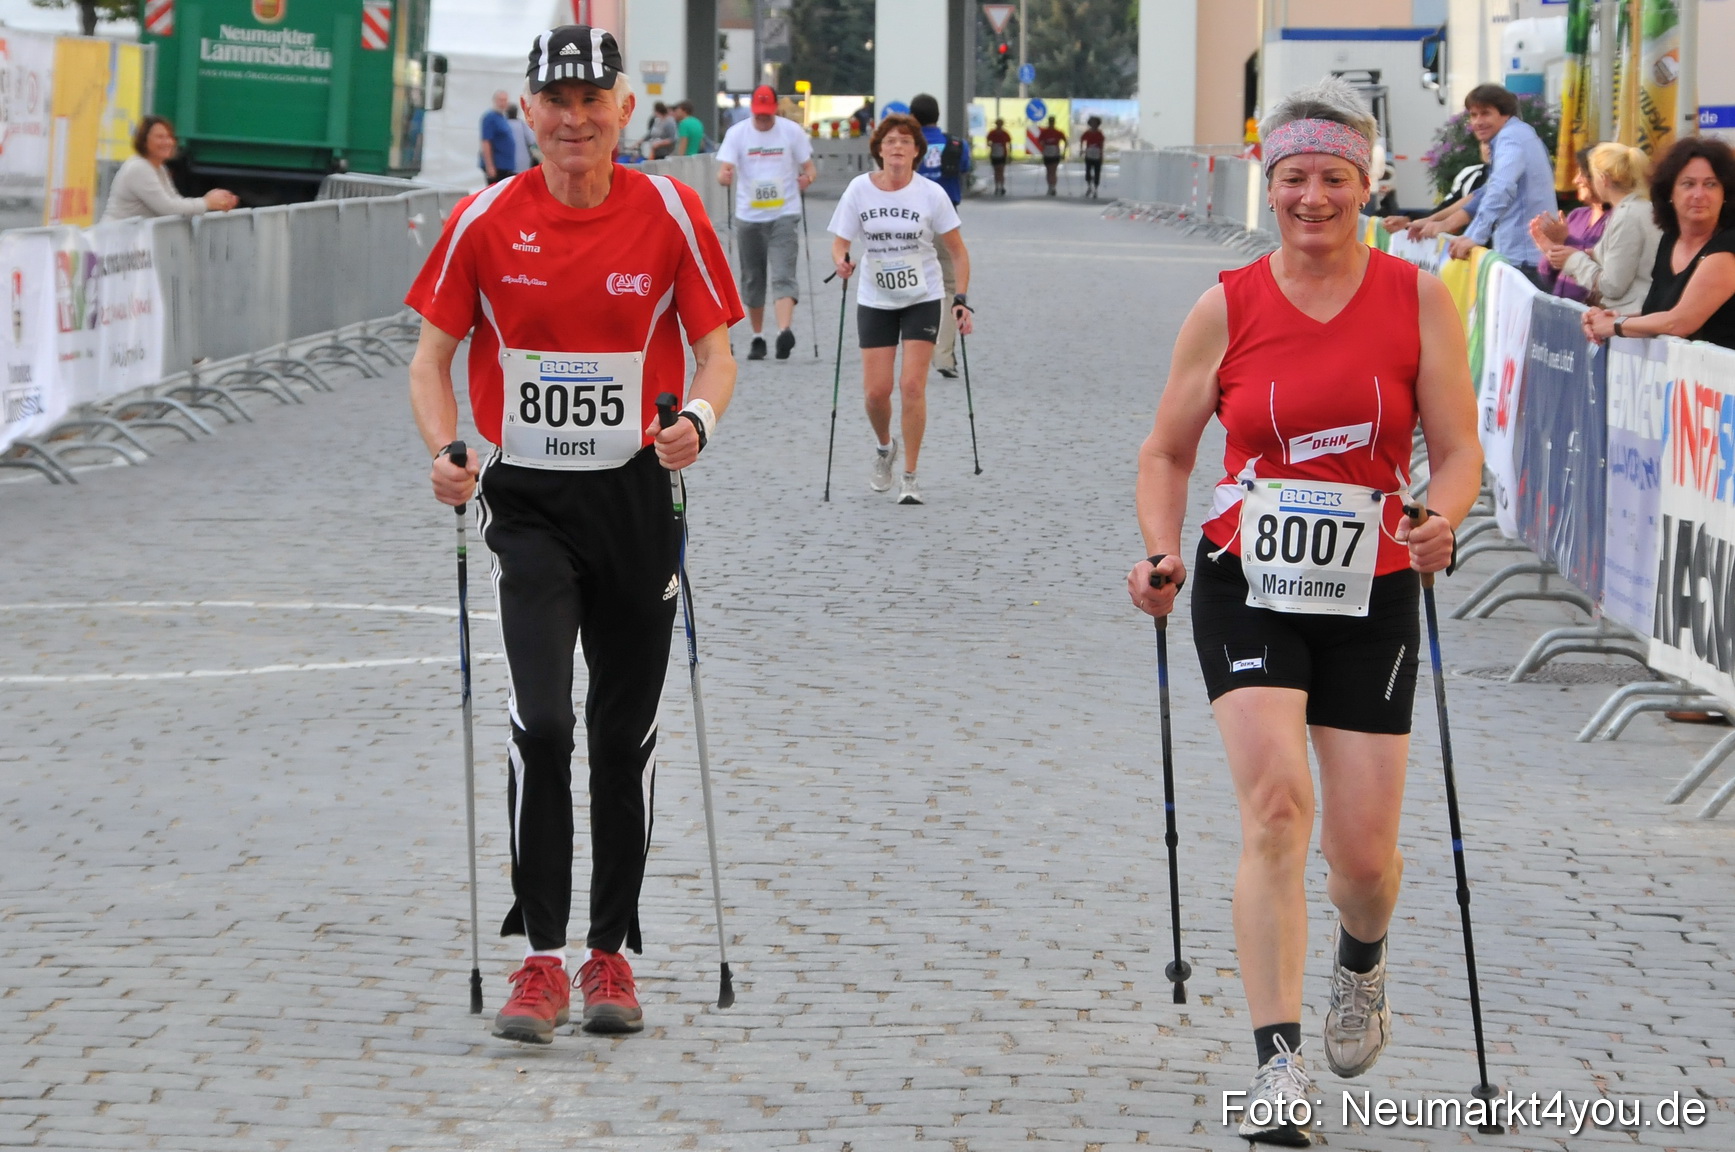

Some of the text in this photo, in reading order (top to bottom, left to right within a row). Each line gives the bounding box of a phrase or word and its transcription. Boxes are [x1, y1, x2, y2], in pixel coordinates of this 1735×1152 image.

[220, 24, 316, 45] Neumarkter
[201, 37, 332, 69] Lammsbräu
[755, 186, 778, 200] 866
[860, 207, 920, 223] BERGER
[512, 242, 541, 253] erima
[876, 268, 918, 290] 8085
[540, 360, 599, 374] BOCK
[519, 382, 625, 428] 8055
[545, 437, 596, 456] Horst
[1312, 433, 1349, 450] DEHN
[1279, 488, 1343, 507] BOCK
[1255, 514, 1366, 568] 8007
[1262, 573, 1346, 599] Marianne
